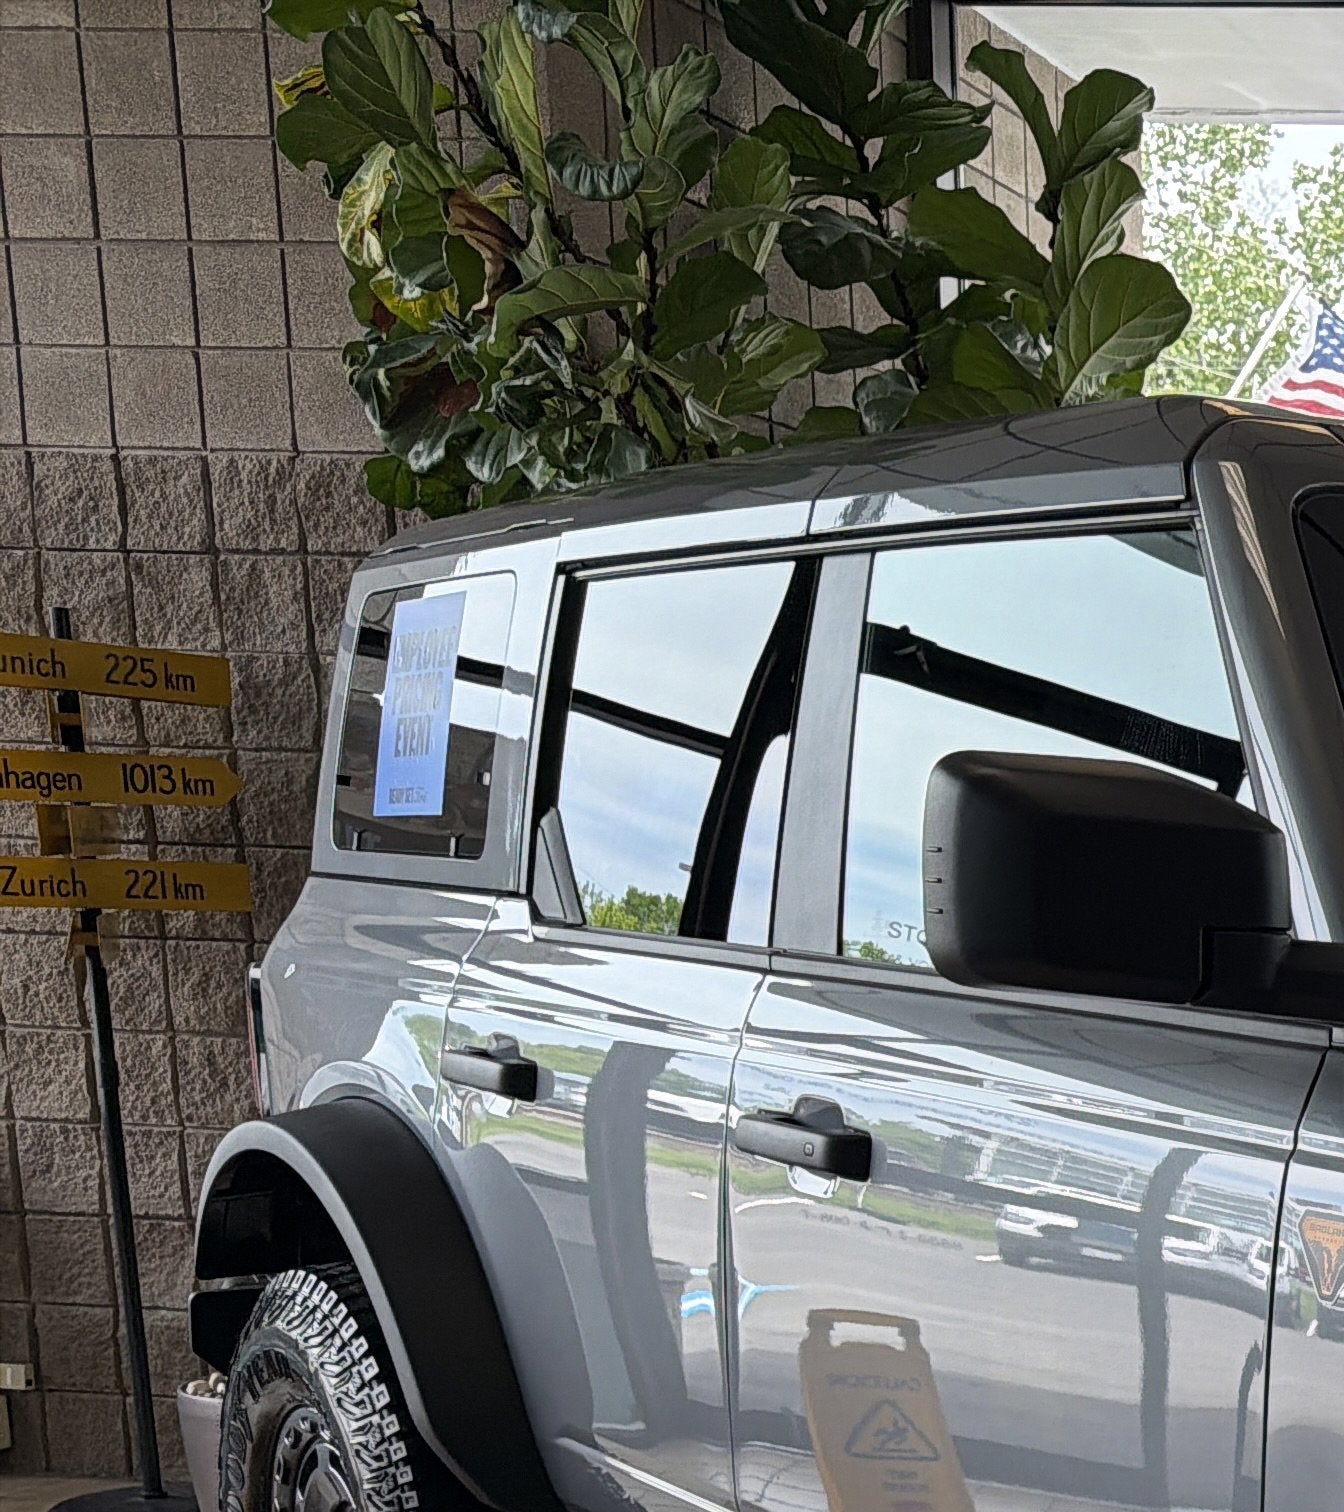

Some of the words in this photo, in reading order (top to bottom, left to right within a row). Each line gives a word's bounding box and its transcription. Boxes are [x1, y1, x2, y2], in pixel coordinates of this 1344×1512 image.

[104, 653, 158, 689] 225
[164, 663, 196, 693] km
[394, 715, 434, 757] EVENT
[0, 758, 82, 798] hagen
[121, 763, 177, 795] 1013
[181, 768, 215, 797] km
[0, 865, 87, 898] Zurich
[124, 869, 167, 900] 221
[173, 874, 205, 901] km
